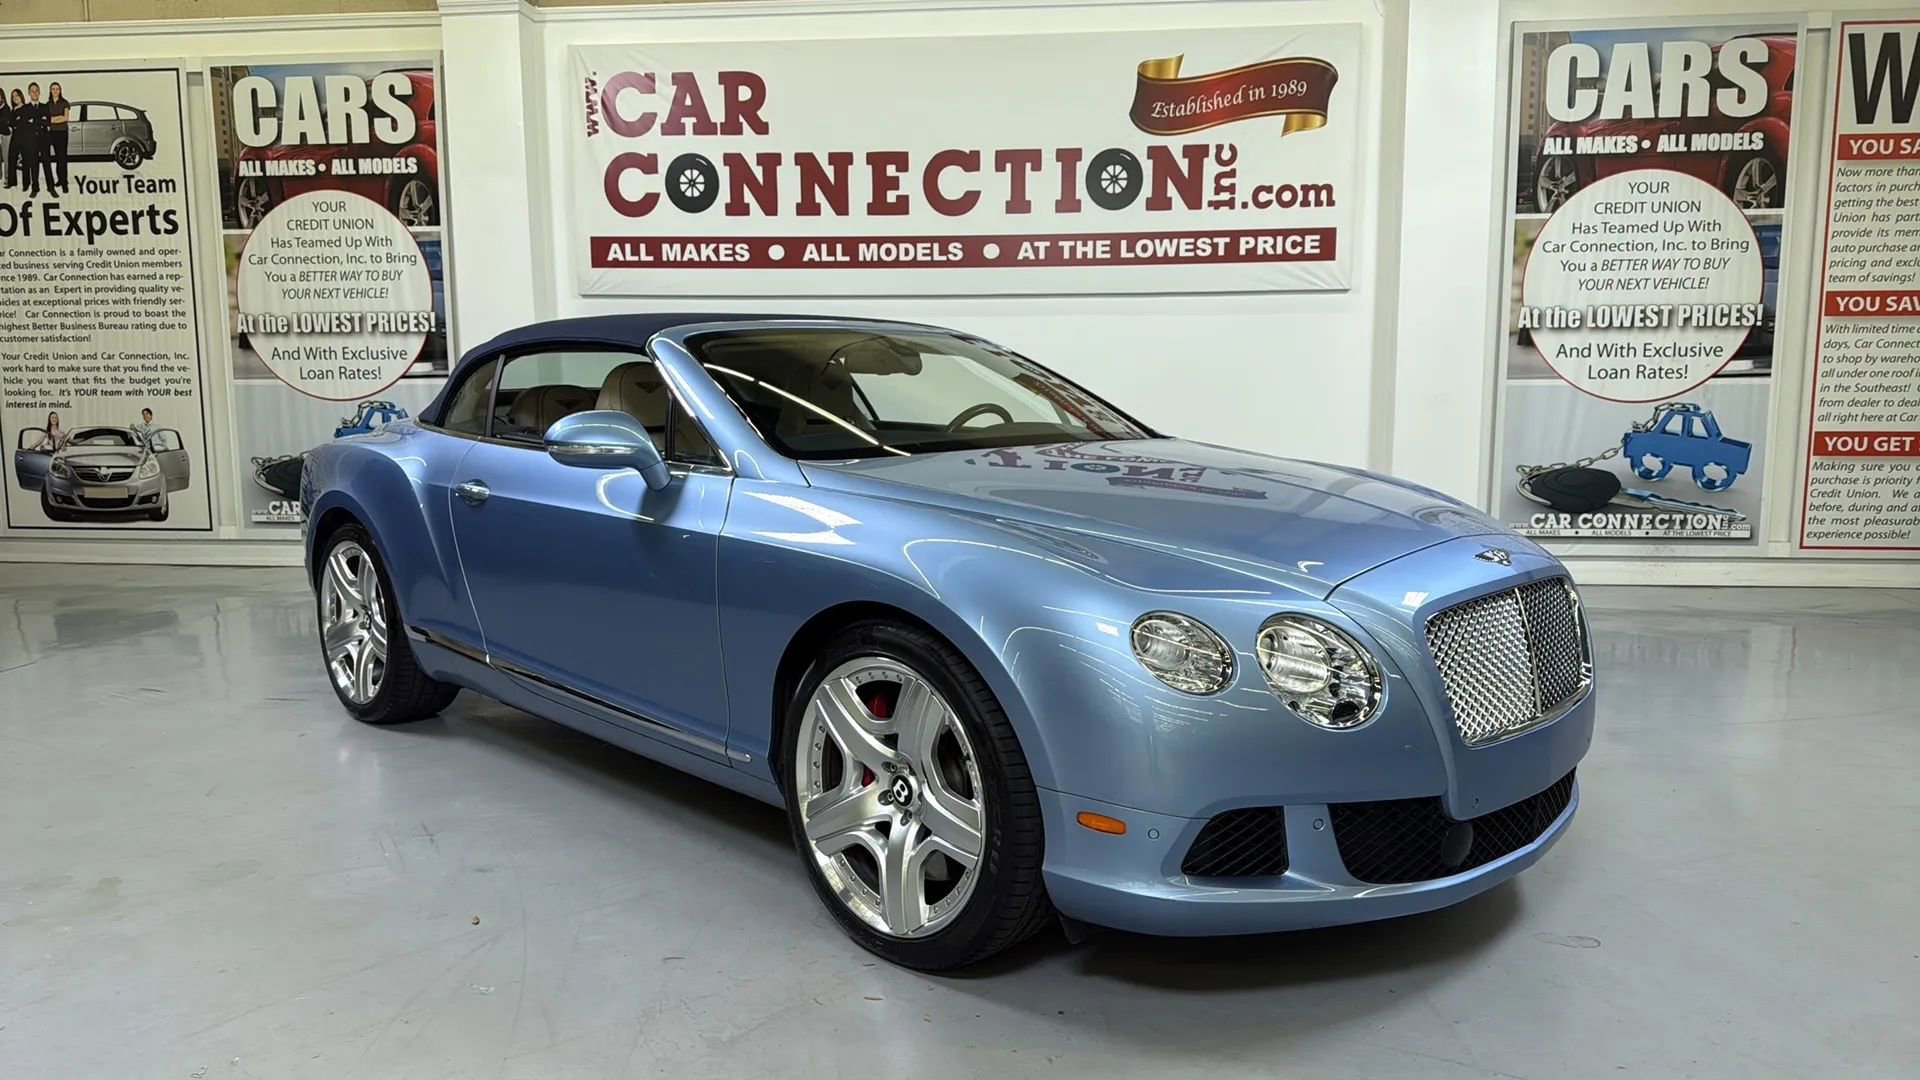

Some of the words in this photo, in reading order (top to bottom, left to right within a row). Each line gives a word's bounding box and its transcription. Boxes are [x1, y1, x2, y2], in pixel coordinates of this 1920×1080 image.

[1546, 38, 1769, 122] CARS
[1848, 32, 1920, 124] W
[585, 71, 599, 137] www.
[601, 71, 769, 138] CAR
[1151, 85, 1244, 118] Established
[1248, 85, 1264, 101] in
[1271, 80, 1307, 101] 1989
[233, 72, 416, 147] CARS
[1543, 138, 1572, 155] ALL
[1577, 136, 1638, 154] MAKES
[1657, 134, 1687, 152] ALL
[1691, 132, 1764, 151] MODELS
[1849, 139, 1894, 155] YOU
[239, 161, 263, 176] ALL
[266, 160, 316, 175] MAKES
[332, 159, 355, 175] ALL
[359, 157, 417, 174] MODELS
[1837, 168, 1862, 176] Now
[1865, 168, 1893, 176] more
[75, 176, 118, 194] Your
[123, 175, 176, 193] Team
[604, 144, 1209, 217] CONNECTION
[1208, 143, 1238, 210] inc
[1241, 184, 1335, 209] .com
[1628, 182, 1669, 194] YOUR
[312, 201, 346, 212] YOUR
[1594, 202, 1647, 214] CREDIT
[1651, 201, 1701, 213] UNION
[43, 203, 179, 245] Experts
[287, 219, 329, 230] CREDIT
[333, 219, 374, 230] UNION
[1572, 222, 1597, 234] Has
[1601, 221, 1658, 233] Teamed
[1663, 221, 1683, 235] Up
[1688, 220, 1721, 232] With
[271, 237, 292, 248] Has
[294, 237, 341, 247] Teamed
[345, 237, 362, 249] Up
[365, 236, 392, 247] With
[607, 244, 653, 261] ALL
[662, 243, 750, 261] MAKES
[803, 243, 849, 261] ALL
[858, 243, 963, 261] MODELS
[1017, 242, 1050, 260] AT
[1059, 241, 1111, 259] THE
[1120, 237, 1230, 258] LOWEST
[1239, 235, 1320, 255] PRICE
[1543, 241, 1565, 253] Car
[1570, 240, 1657, 253] Connection,
[1662, 240, 1687, 251] Inc.
[1692, 241, 1706, 250] to
[1711, 239, 1749, 253] Bring
[249, 254, 267, 265] Car
[271, 254, 343, 265] Connection,
[347, 254, 366, 264] Inc.
[371, 255, 382, 263] to
[386, 253, 417, 265] Bring
[1560, 260, 1587, 272] You
[1591, 263, 1597, 271] a
[1601, 259, 1647, 271] BETTER
[1651, 258, 1680, 270] WAY
[1683, 258, 1700, 269] TO
[1703, 257, 1730, 269] BUY
[265, 272, 287, 282] You
[299, 271, 336, 281] BETTER
[340, 271, 362, 281] WAY
[366, 271, 379, 280] TO
[382, 270, 402, 280] BUY
[1829, 274, 1856, 282] team
[1859, 272, 1871, 282] of
[1872, 273, 1915, 284] savings!
[1578, 279, 1613, 291] YOUR
[1617, 278, 1650, 290] NEXT
[1653, 277, 1709, 290] VEHICLE!
[282, 288, 310, 299] YOUR
[314, 288, 340, 299] NEXT
[343, 288, 388, 298] VEHICLE!
[1836, 297, 1880, 311] YOU
[237, 313, 255, 333] At
[259, 313, 288, 333] the
[293, 312, 361, 333] LOWEST
[367, 312, 436, 332] PRICES!
[1518, 306, 1539, 329] At
[1546, 306, 1581, 328] the
[1587, 305, 1672, 328] LOWEST
[1678, 303, 1763, 327] PRICES!
[24, 352, 49, 360] Credit
[81, 352, 98, 360] and
[119, 352, 170, 361] Connection,
[174, 352, 189, 360] Inc.
[272, 347, 300, 360] And
[303, 347, 337, 360] With
[343, 347, 408, 360] Exclusive
[1556, 344, 1591, 358] And
[1597, 343, 1637, 358] With
[1643, 342, 1723, 357] Exclusive
[300, 367, 334, 379] Loan
[339, 366, 381, 379] Rates!
[1588, 365, 1630, 379] Loan
[1636, 364, 1688, 379] Rates!
[28, 378, 42, 386] you
[94, 376, 107, 384] fits
[129, 376, 160, 386] budget
[1820, 384, 1830, 392] in
[1834, 383, 1851, 392] the
[1854, 383, 1911, 392] Southeast!
[5, 389, 36, 398] looking
[39, 388, 54, 396] for.
[1824, 437, 1868, 451] YOU
[1874, 437, 1914, 451] GET
[1812, 462, 1855, 473] Making
[1889, 464, 1911, 473] you
[1809, 503, 1844, 512] before,
[1848, 503, 1883, 514] during
[1887, 503, 1908, 512] and
[1531, 513, 1571, 528] CAR
[1578, 512, 1722, 530] CONNECTION
[1807, 531, 1862, 540] experience
[1864, 530, 1910, 540] possible!
